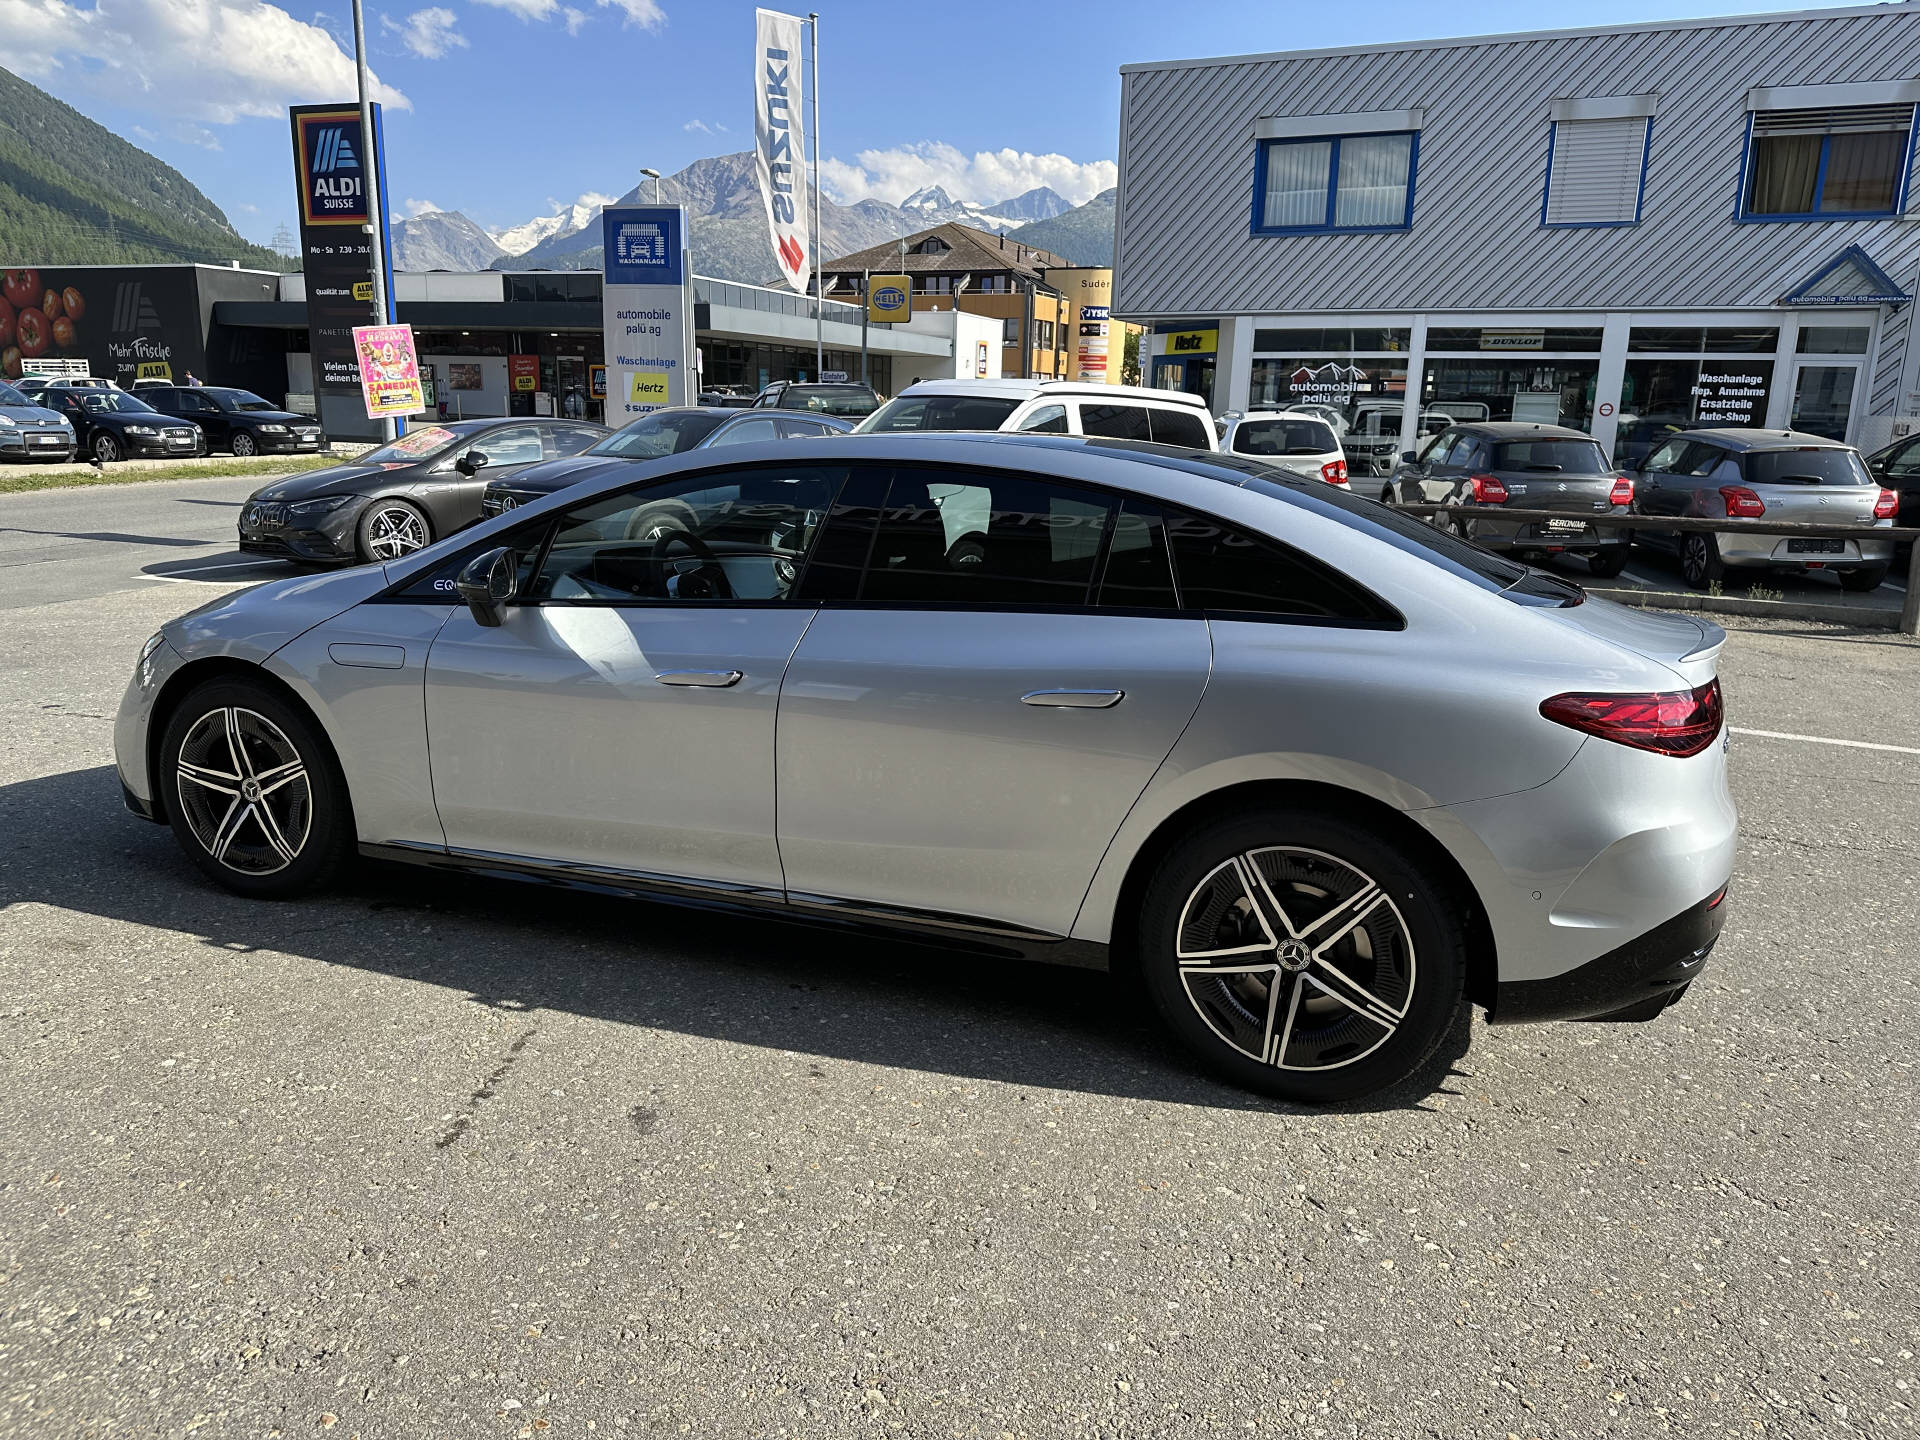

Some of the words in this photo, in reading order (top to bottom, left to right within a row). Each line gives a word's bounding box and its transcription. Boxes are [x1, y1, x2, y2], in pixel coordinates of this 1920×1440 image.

[315, 177, 361, 197] ALDI
[324, 199, 354, 209] SUISSE
[310, 246, 320, 254] Mo
[325, 246, 334, 254] Sa
[315, 288, 337, 296] Qualität
[875, 294, 905, 304] HELLA
[616, 308, 671, 320] automobile
[1085, 308, 1109, 318] JYSK
[626, 322, 647, 335] palü
[649, 325, 661, 337] ag
[1174, 334, 1203, 350] Hertz
[109, 343, 132, 357] Mehr
[130, 337, 171, 360] Frische
[323, 362, 347, 371] Vielen
[348, 363, 359, 371] Da
[616, 355, 677, 368] Waschanlage
[117, 363, 136, 372] zum
[143, 364, 166, 377] ALDI
[325, 373, 350, 382] deinen
[351, 374, 361, 382] Be
[823, 373, 845, 381] Einfahrt
[1698, 374, 1763, 385] Waschanlage
[367, 380, 419, 392] SAMEDAN
[636, 382, 664, 393] Hertz
[1691, 386, 1713, 397] Rep.
[1718, 387, 1765, 397] Annahme
[1302, 393, 1331, 404] palü
[1333, 394, 1350, 405] ag
[1700, 399, 1753, 409] Ersatzteile
[1699, 411, 1751, 423] Auto-Shop
[433, 579, 457, 591] EQ
